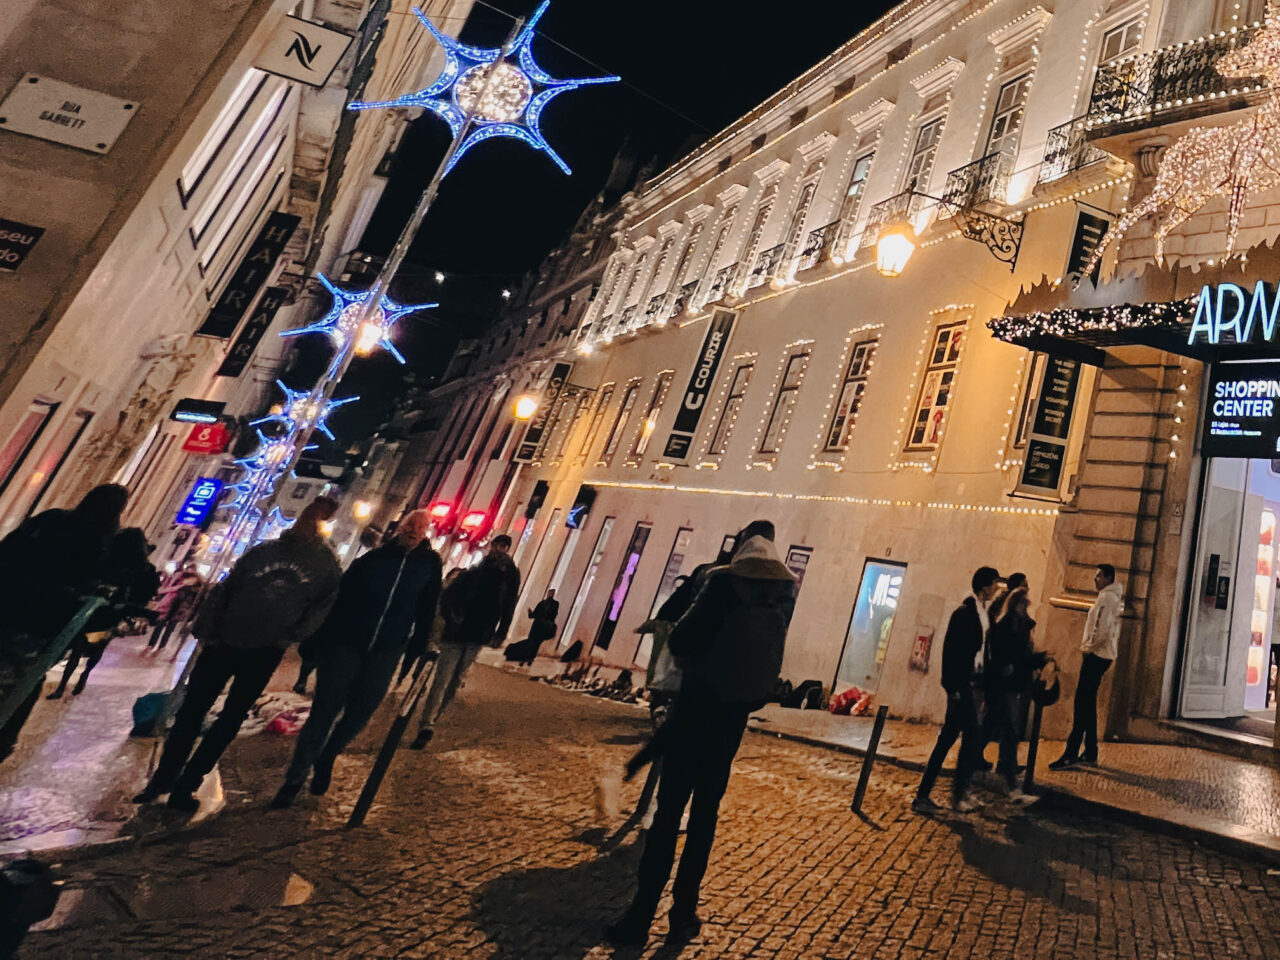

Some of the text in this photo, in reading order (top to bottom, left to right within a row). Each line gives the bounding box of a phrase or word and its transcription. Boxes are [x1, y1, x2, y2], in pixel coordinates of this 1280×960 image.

[39, 111, 86, 128] GARRETT
[61, 101, 81, 113] RUA
[223, 226, 288, 309] HAIR
[235, 297, 277, 357] HAIR
[695, 331, 724, 389] COURIR
[532, 377, 563, 429] MANGO
[1213, 400, 1274, 417] CENTER
